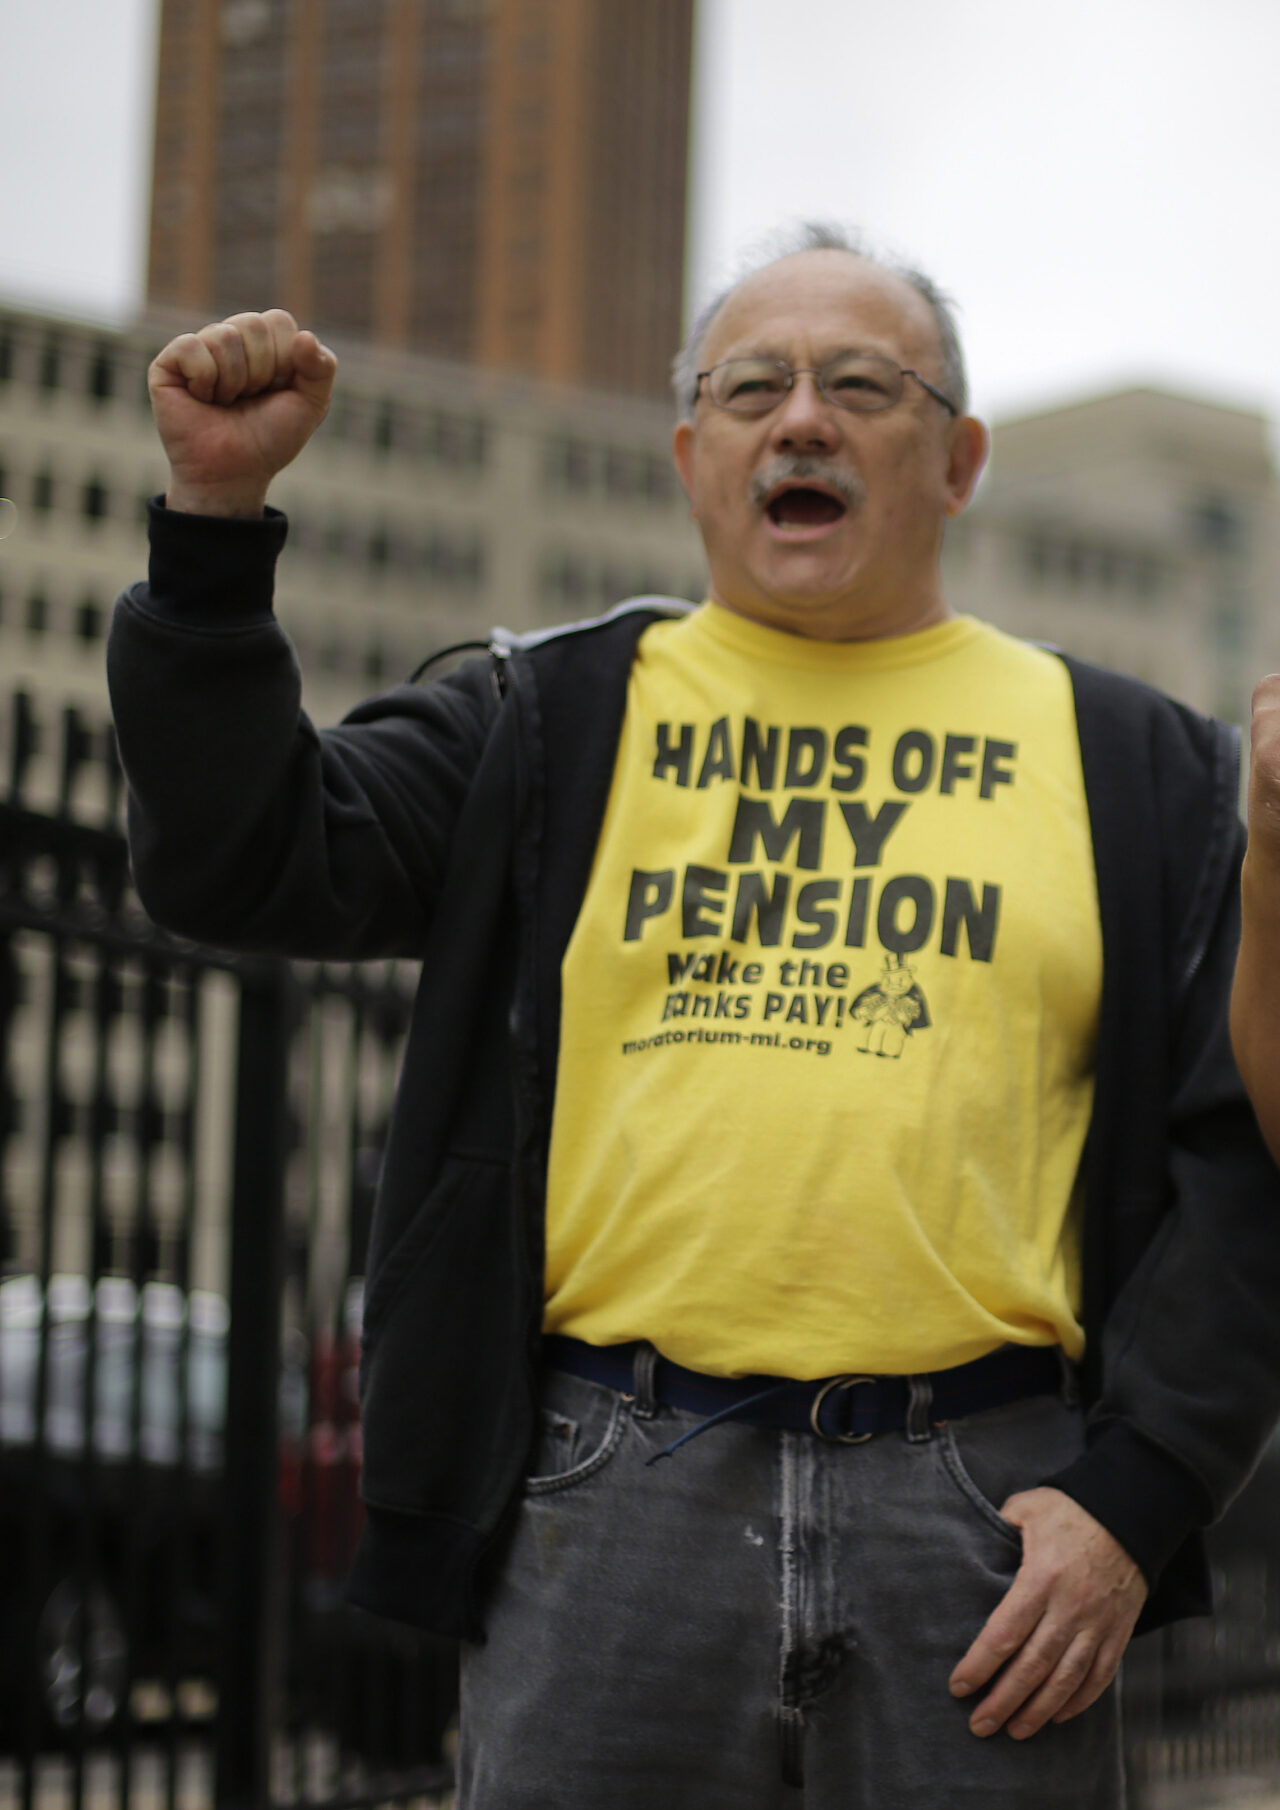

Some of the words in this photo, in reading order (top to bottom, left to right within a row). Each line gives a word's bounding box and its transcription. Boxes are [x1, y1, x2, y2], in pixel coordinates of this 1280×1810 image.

[652, 715, 870, 793] HANDS
[892, 729, 1018, 799] OFF
[728, 795, 912, 870] MY
[623, 863, 1002, 963] PENSION
[667, 950, 764, 985] Make
[779, 958, 849, 989] the
[763, 993, 847, 1028] PAY!
[622, 1028, 831, 1055] moratorium-mi.org
